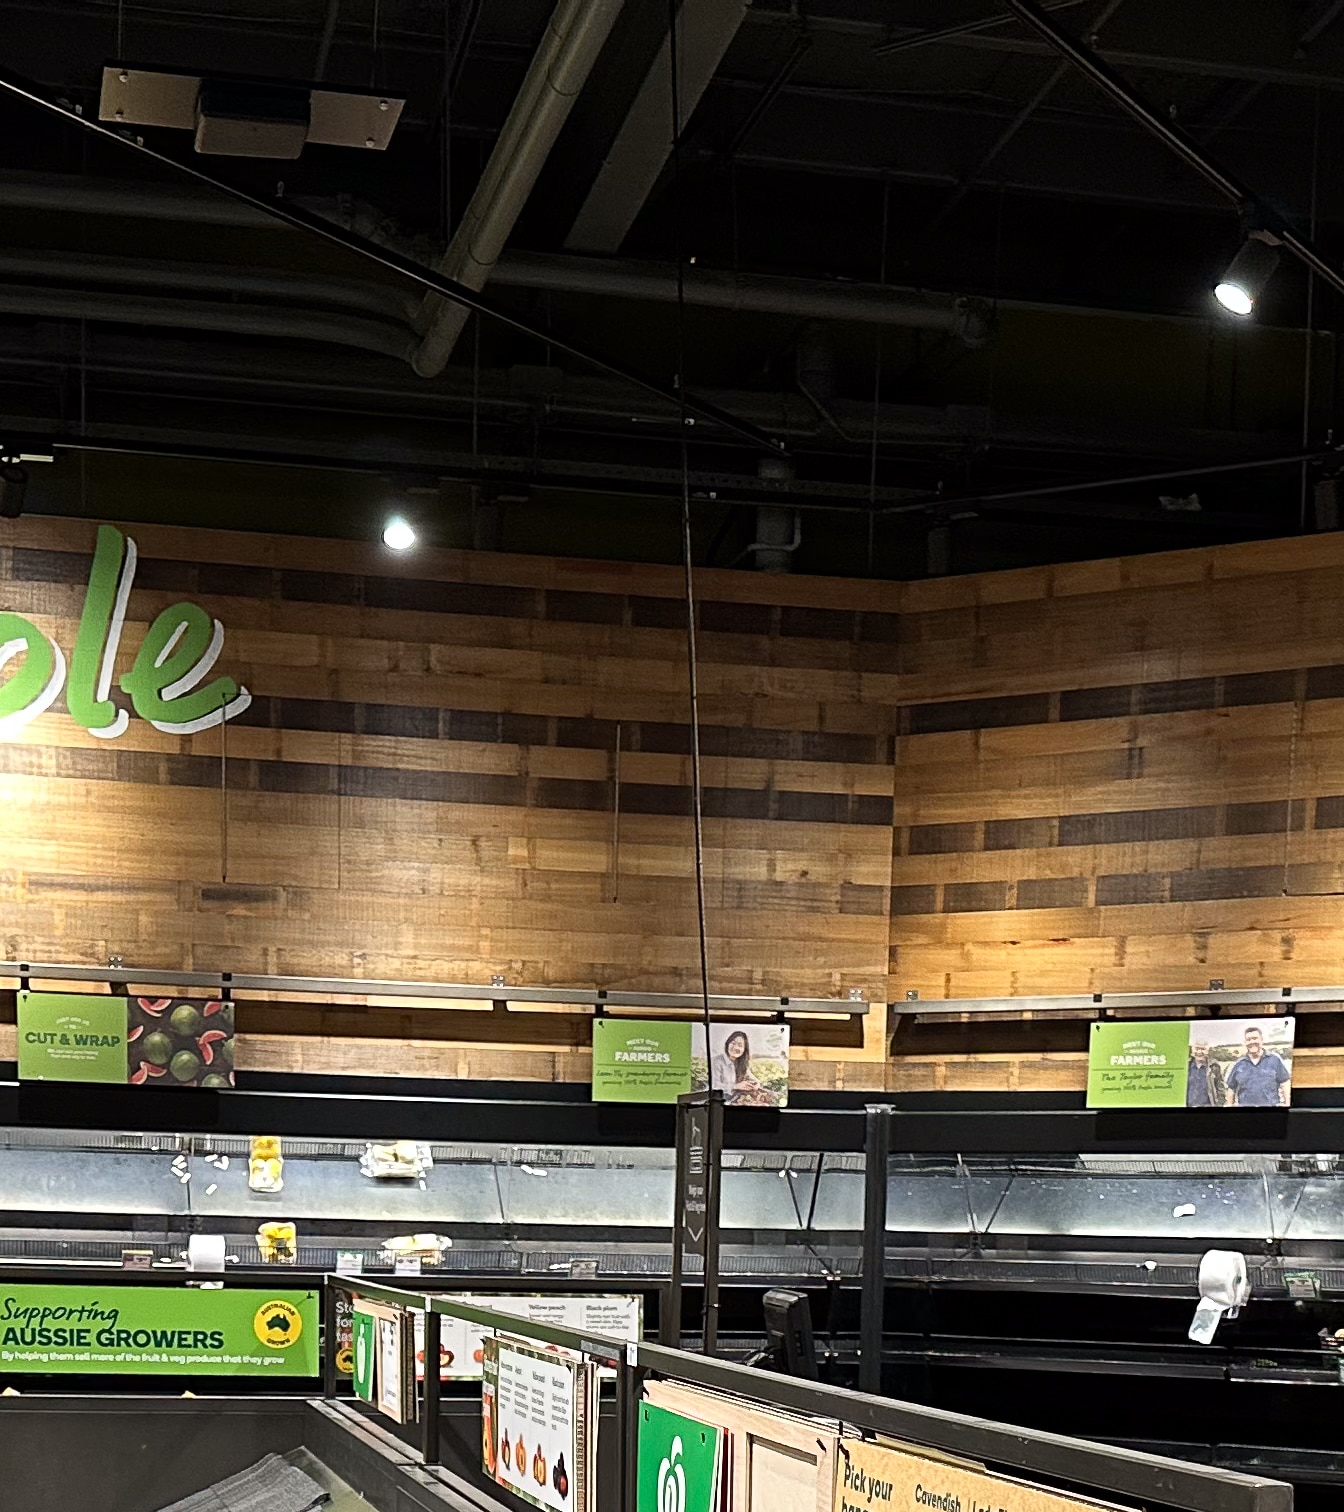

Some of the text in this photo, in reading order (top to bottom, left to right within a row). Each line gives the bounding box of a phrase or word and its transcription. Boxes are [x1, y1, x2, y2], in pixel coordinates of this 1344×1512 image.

[25, 1032, 120, 1047] CUT & WRAP
[614, 1051, 670, 1063] FARMERS
[1110, 1055, 1167, 1066] FARMERS
[0, 1297, 119, 1329] Supporting
[261, 1303, 296, 1316] AUSTRALIAN
[2, 1327, 224, 1349] AUSSIE GROWERS
[1, 1351, 14, 1361] By
[15, 1351, 49, 1362] helping
[50, 1352, 74, 1360] them
[75, 1352, 90, 1361] sell
[115, 1352, 125, 1361] of
[125, 1352, 141, 1361] the
[142, 1353, 160, 1362] fruit
[161, 1354, 169, 1362] &
[170, 1355, 185, 1365] veg
[187, 1354, 222, 1364] produce
[223, 1354, 242, 1363] that
[243, 1355, 262, 1366] they
[263, 1356, 285, 1365] grow
[844, 1462, 893, 1503] Pick your
